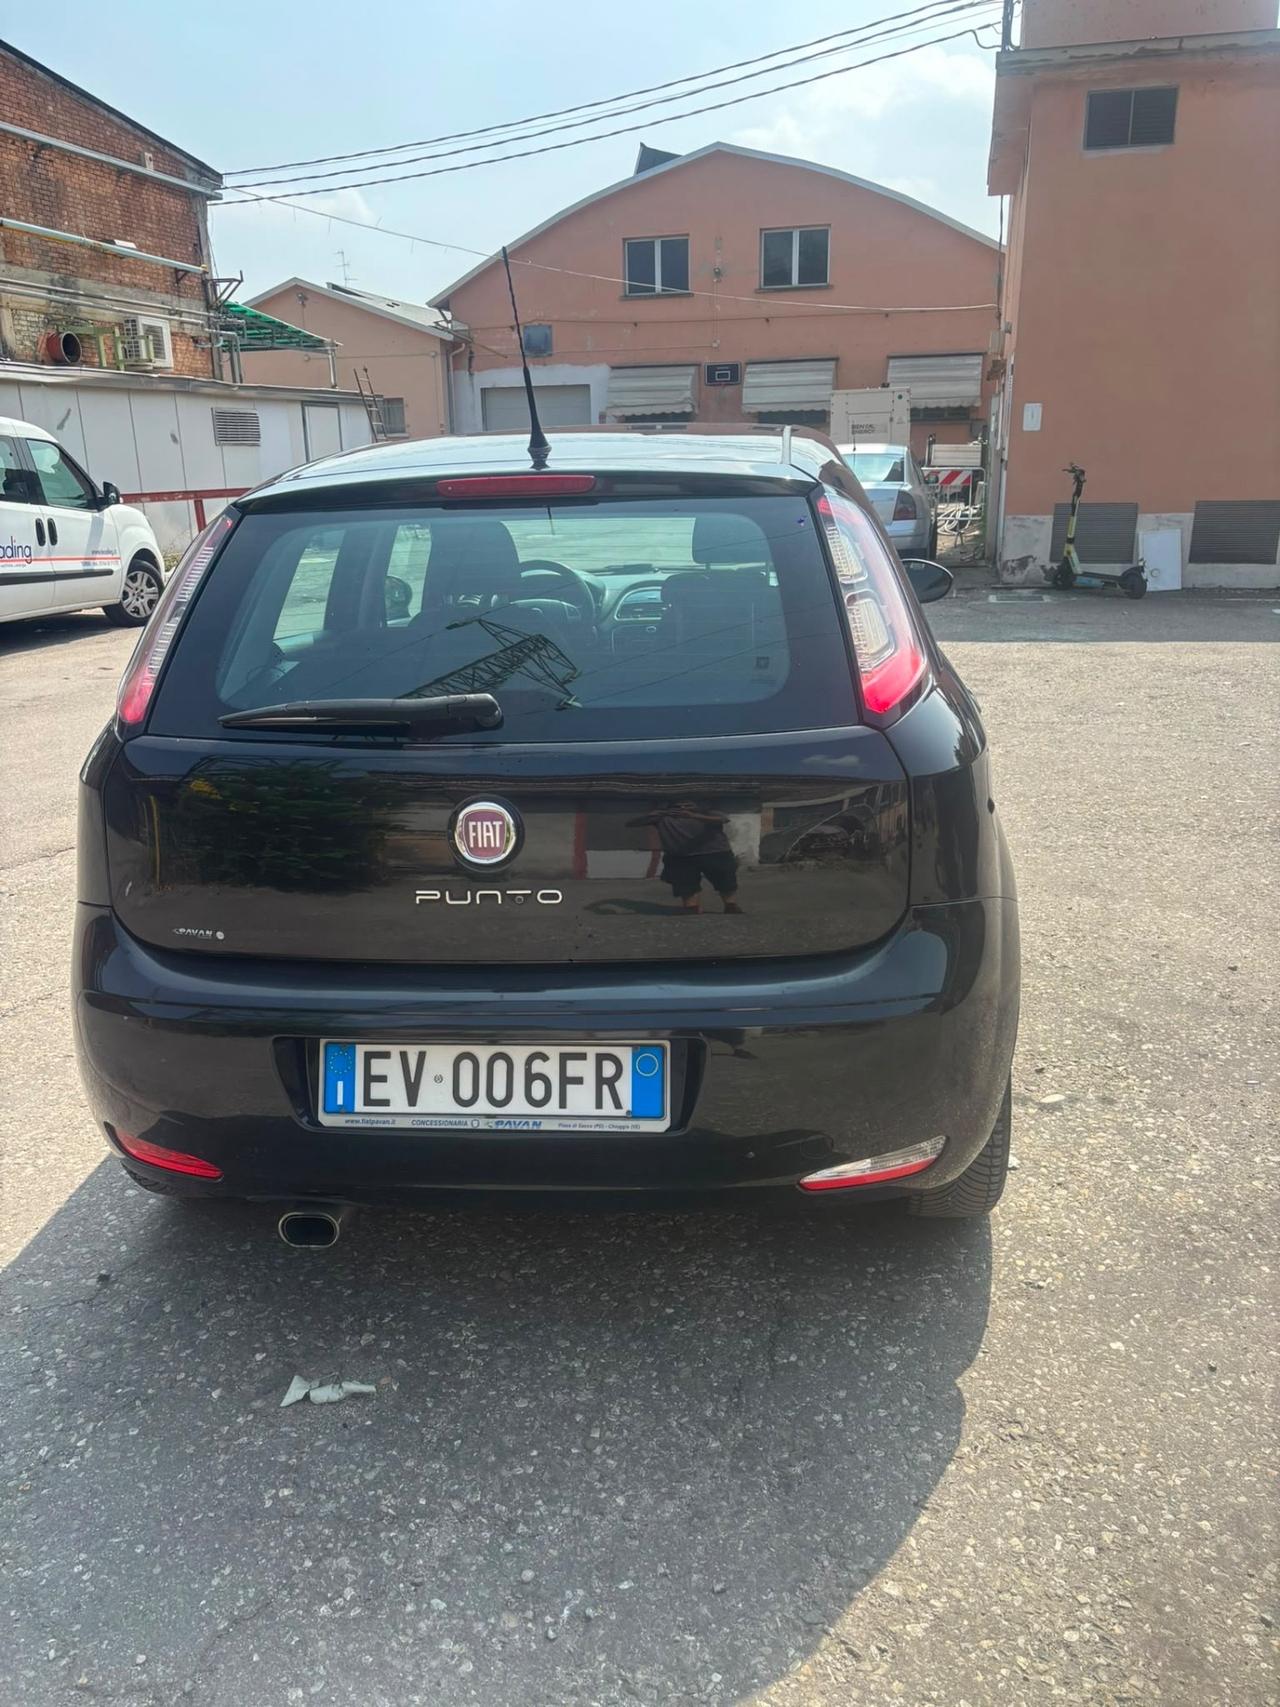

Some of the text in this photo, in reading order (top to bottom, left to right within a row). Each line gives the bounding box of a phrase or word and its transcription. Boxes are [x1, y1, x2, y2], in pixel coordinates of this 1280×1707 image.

[468, 821, 503, 848] FIAT
[415, 889, 563, 905] PUNTO
[411, 1119, 468, 1127] CONCESSIONARIA
[496, 1120, 542, 1129] PAVAN
